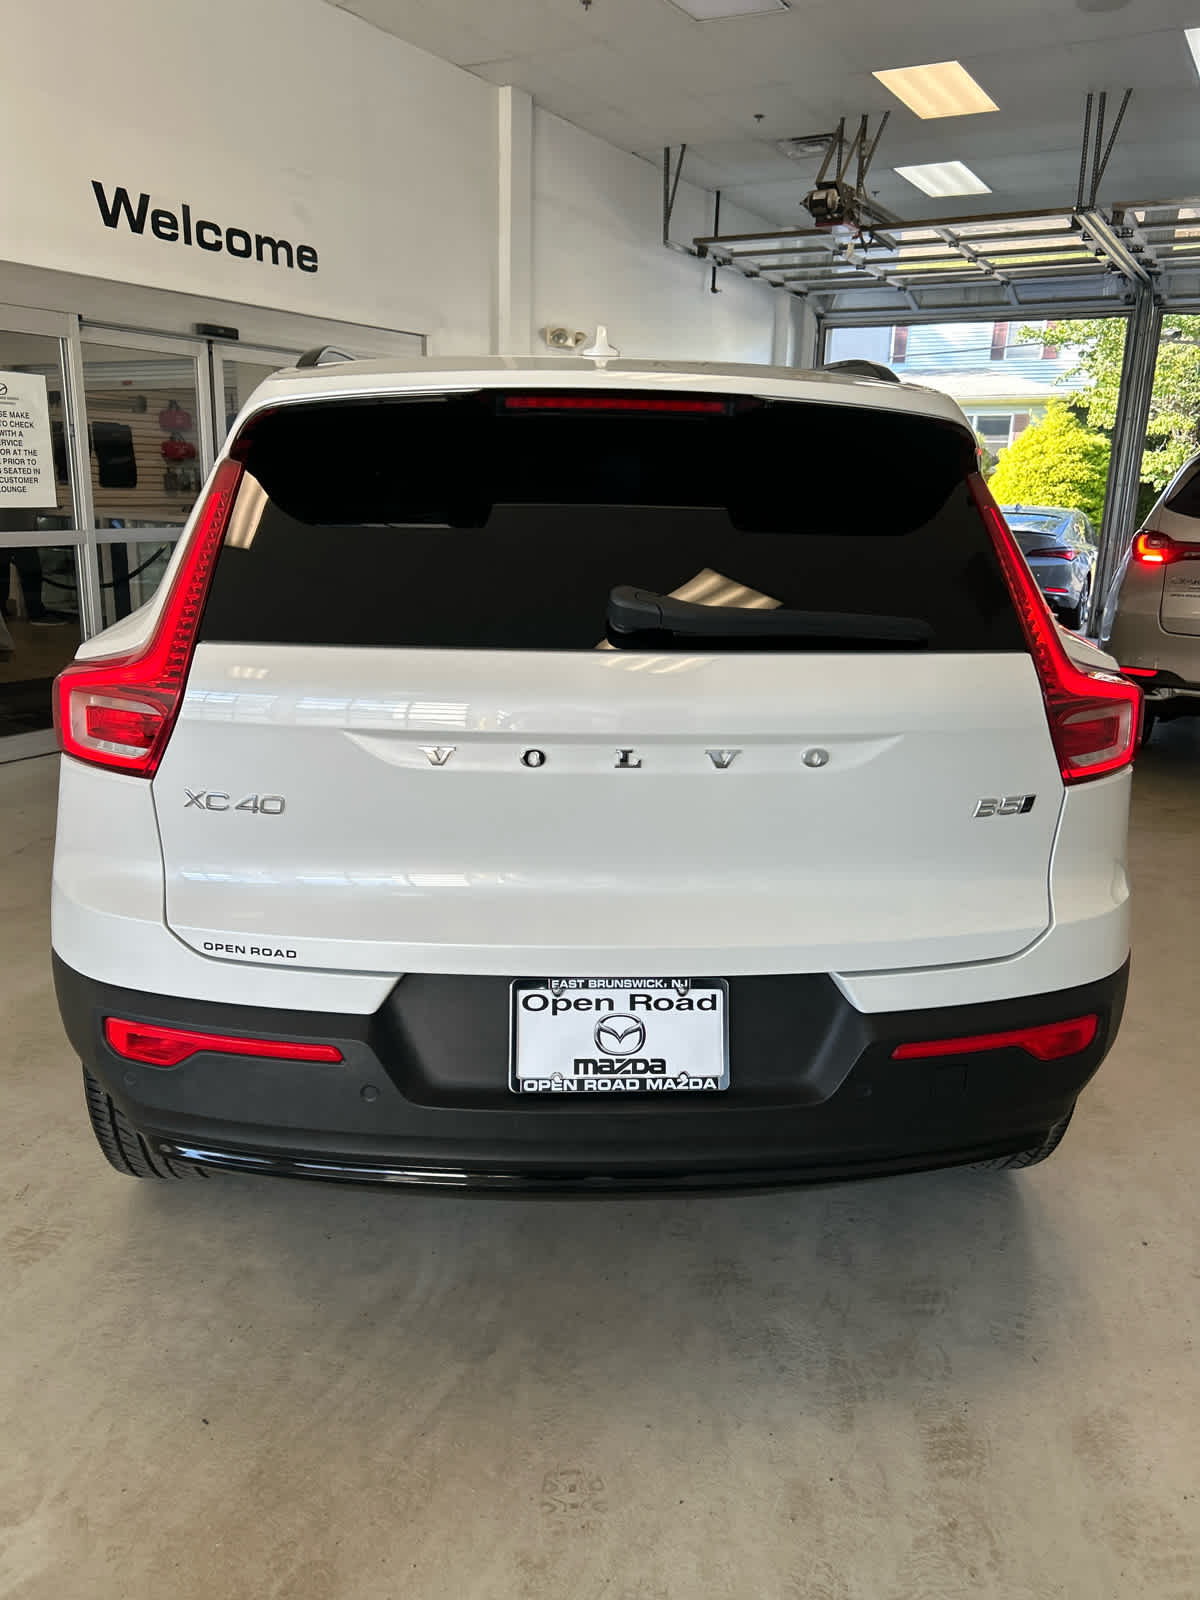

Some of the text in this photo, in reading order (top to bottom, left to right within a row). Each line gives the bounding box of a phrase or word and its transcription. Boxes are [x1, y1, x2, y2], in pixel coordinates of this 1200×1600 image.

[91, 180, 318, 273] Welcome
[10, 411, 30, 419] MAKE
[10, 421, 34, 429] CHECK
[18, 430, 24, 438] A
[0, 439, 23, 447] RVICE
[24, 449, 38, 457] THE
[3, 457, 37, 466] PRIOR TO
[4, 467, 32, 475] SEATED
[0, 476, 39, 484] CUSTOMER
[0, 485, 28, 493] OUNGE
[418, 745, 831, 769] VOLVO
[203, 942, 297, 959] OPEN ROAD
[551, 979, 585, 989] EAST
[671, 979, 689, 989] NJ
[522, 993, 717, 1016] Open Road
[523, 1078, 718, 1092] OPEN ROAD MAZDA
